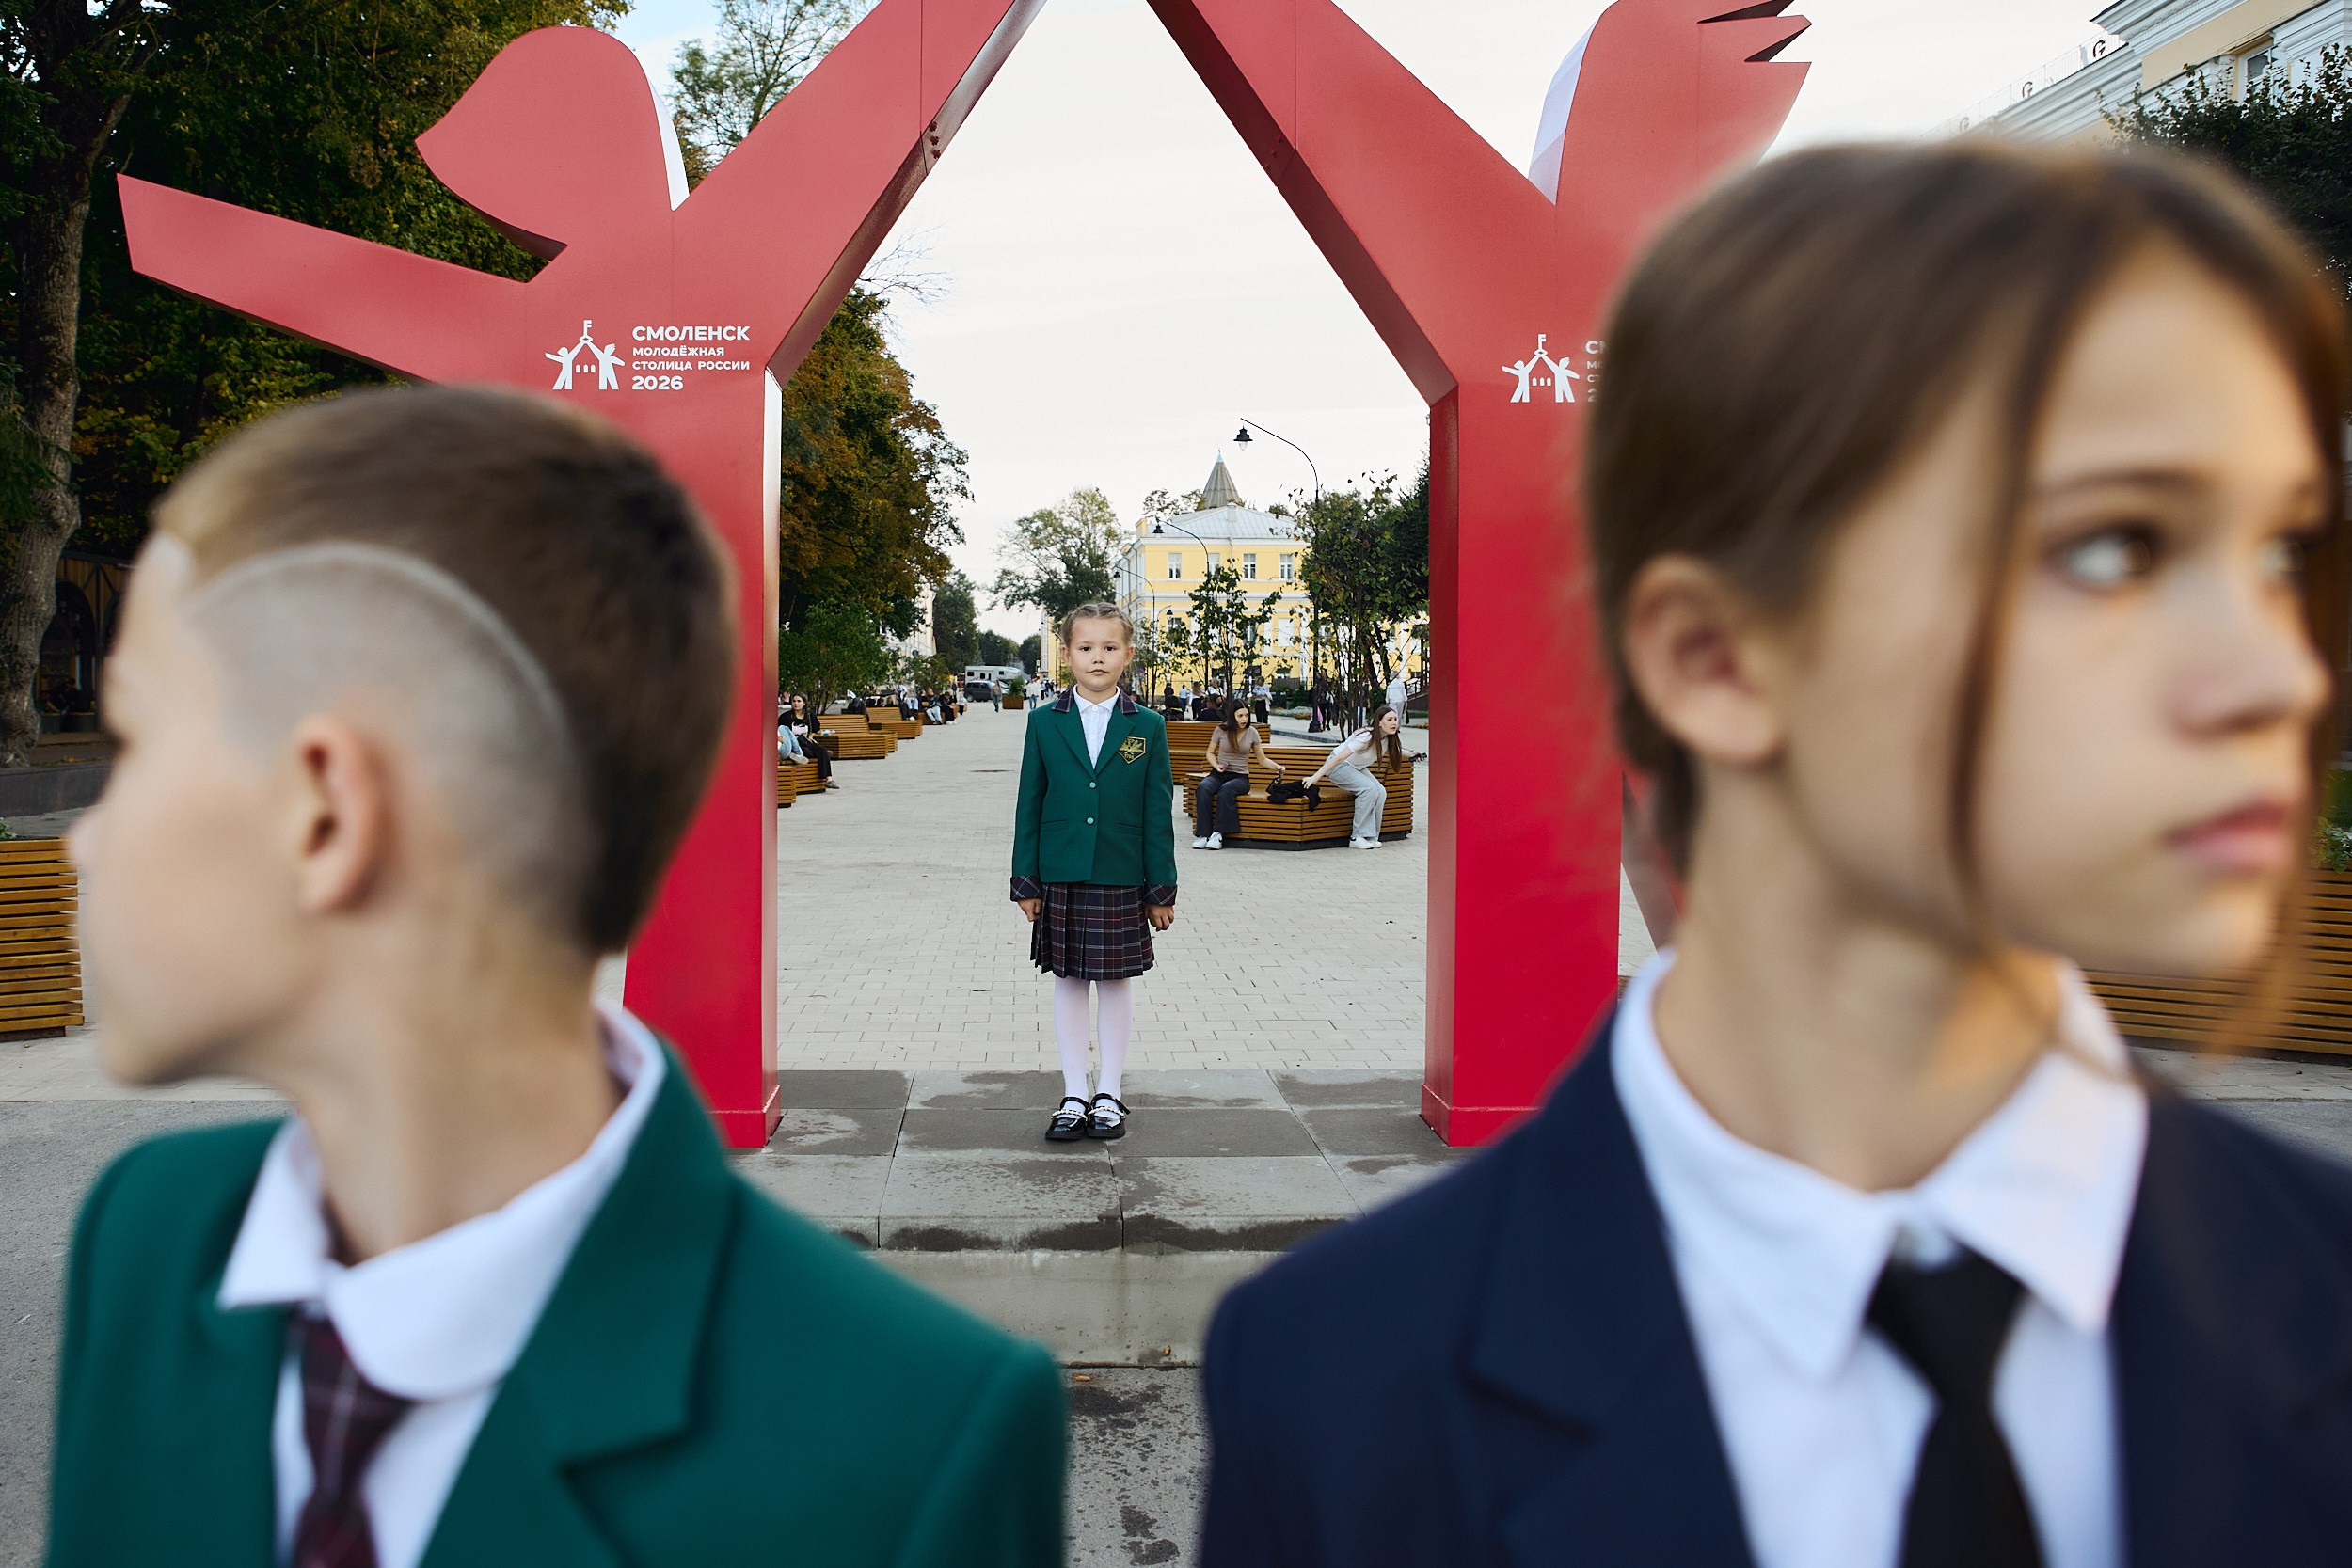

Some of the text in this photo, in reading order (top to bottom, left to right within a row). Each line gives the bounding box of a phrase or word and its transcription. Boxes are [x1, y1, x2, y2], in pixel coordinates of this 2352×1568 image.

[631, 325, 751, 341] СМОЛЕНСК
[632, 345, 724, 356] МОЛОДЁЖНАЯ
[631, 360, 750, 372] СТОЛИЦА РОССИИ
[631, 374, 684, 390] 2026
